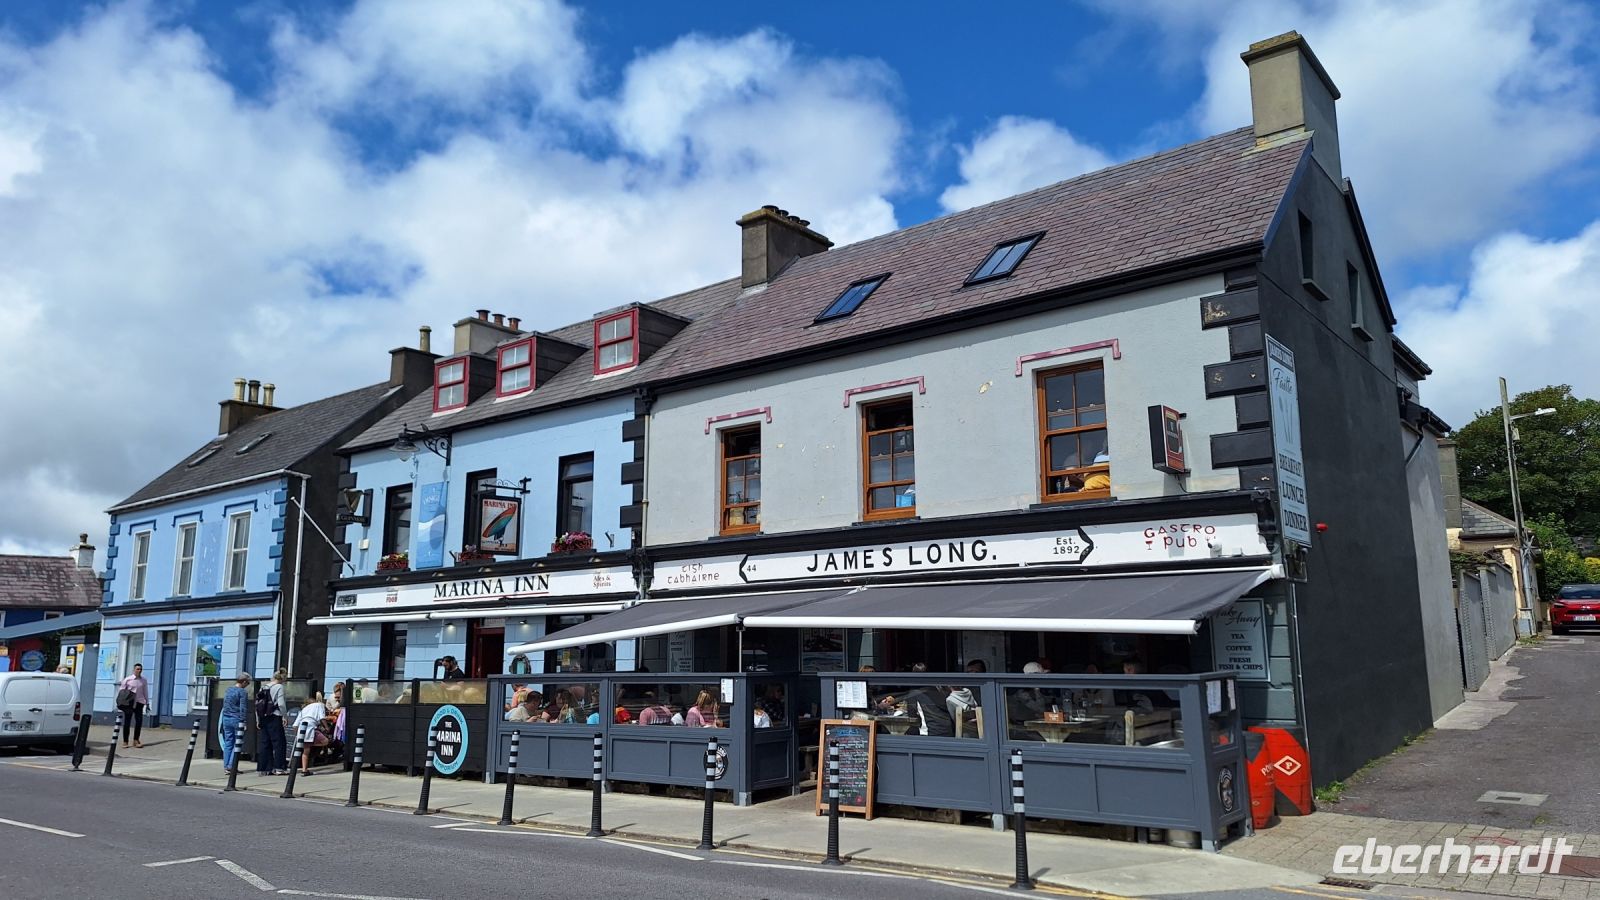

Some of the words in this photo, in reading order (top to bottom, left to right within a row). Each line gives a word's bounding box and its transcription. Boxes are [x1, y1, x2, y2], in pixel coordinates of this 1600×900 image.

[1282, 481, 1305, 504] LUNCH
[1284, 509, 1308, 532] DINNER
[1144, 523, 1216, 539] GASTRO
[1056, 537, 1077, 545] Est.
[806, 547, 893, 572] JAMES
[908, 539, 997, 565] LONG.
[1053, 545, 1080, 555] 1892
[746, 564, 757, 572] 44
[434, 578, 505, 599] MARINA
[514, 574, 551, 593] INN
[441, 744, 454, 757] INN
